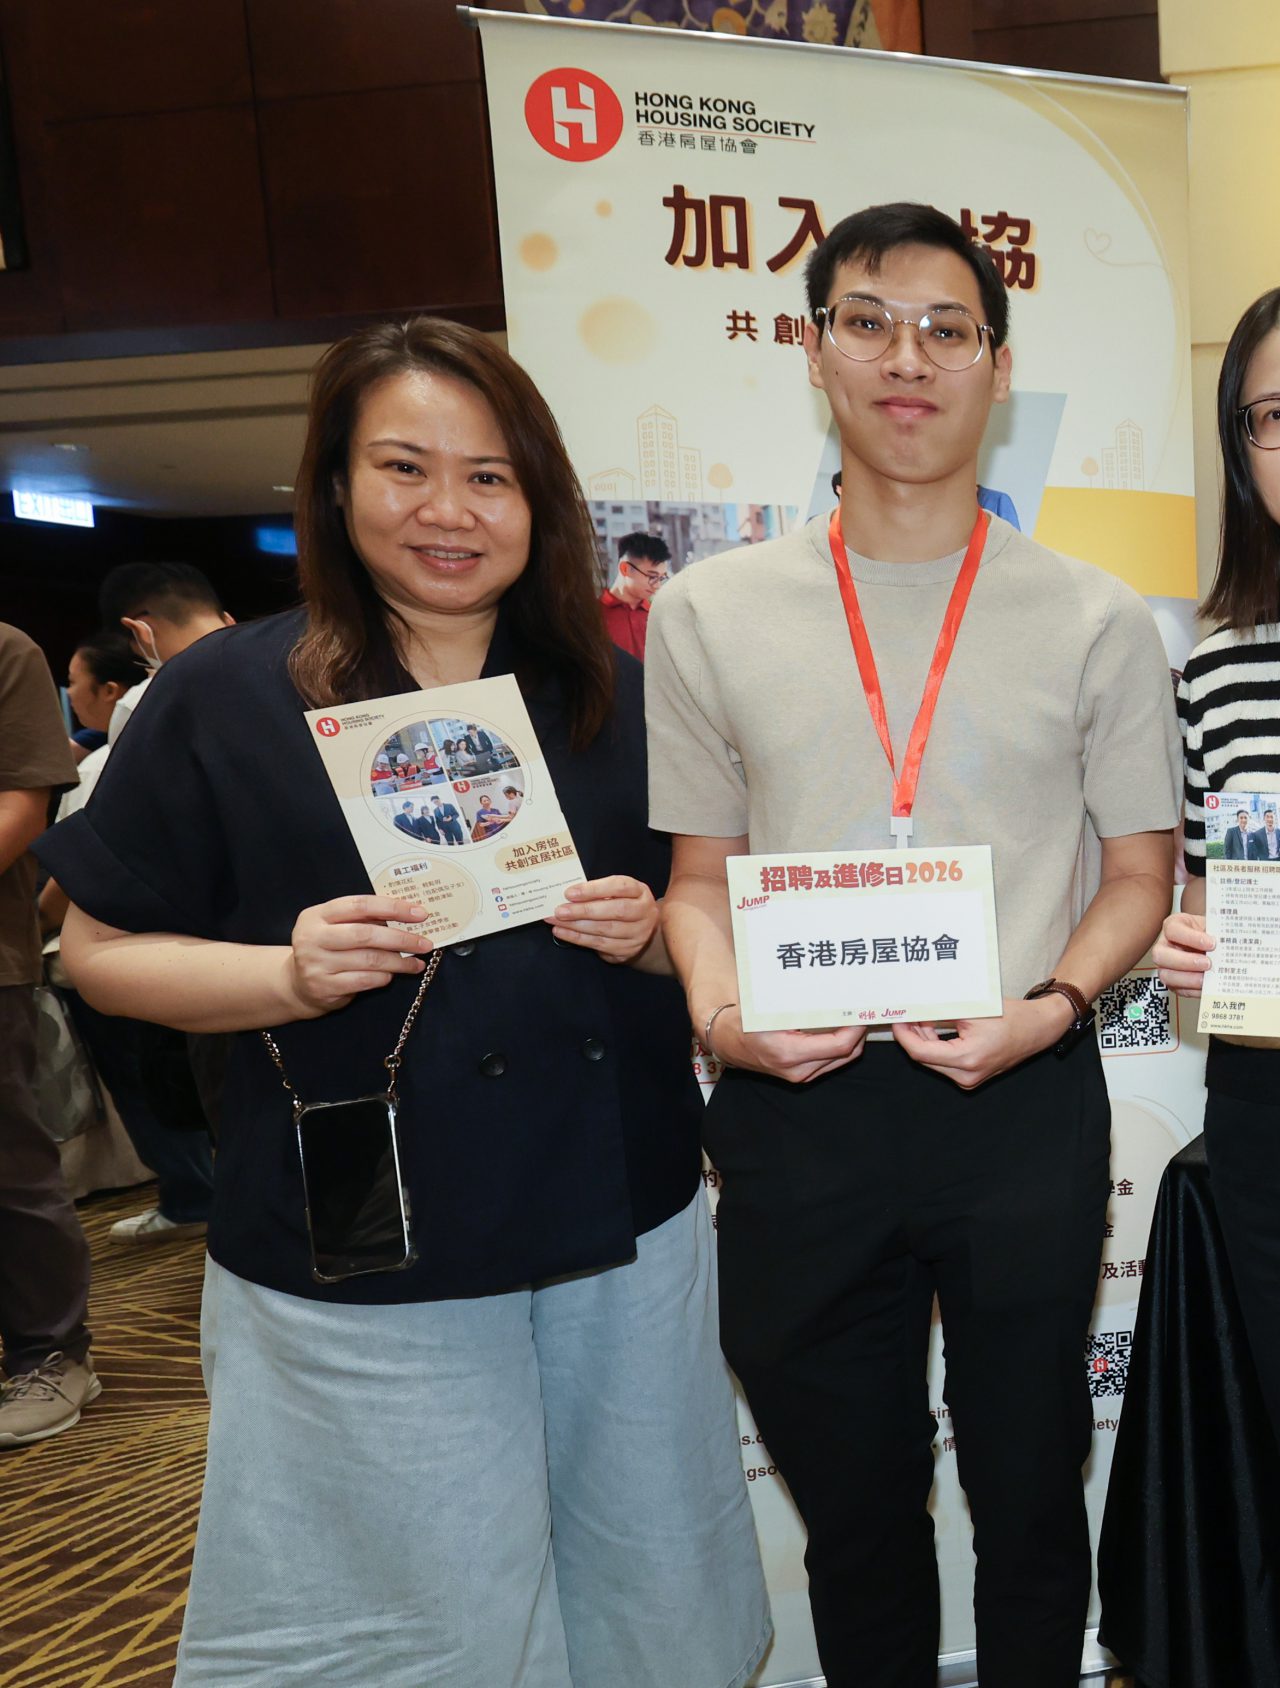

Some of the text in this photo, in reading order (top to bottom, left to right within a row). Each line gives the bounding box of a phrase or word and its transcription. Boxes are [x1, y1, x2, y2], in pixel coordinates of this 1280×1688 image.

[635, 91, 756, 115] HONG KONG
[636, 109, 816, 138] HOUSING SOCIETY
[637, 130, 758, 154] 香港房屋協會
[505, 845, 574, 871] 共創宜居社區
[512, 837, 559, 858] 加入房協
[394, 862, 427, 876] 員工福利
[776, 933, 960, 970] 香港房屋協會
[1212, 1000, 1246, 1011] 加入我們
